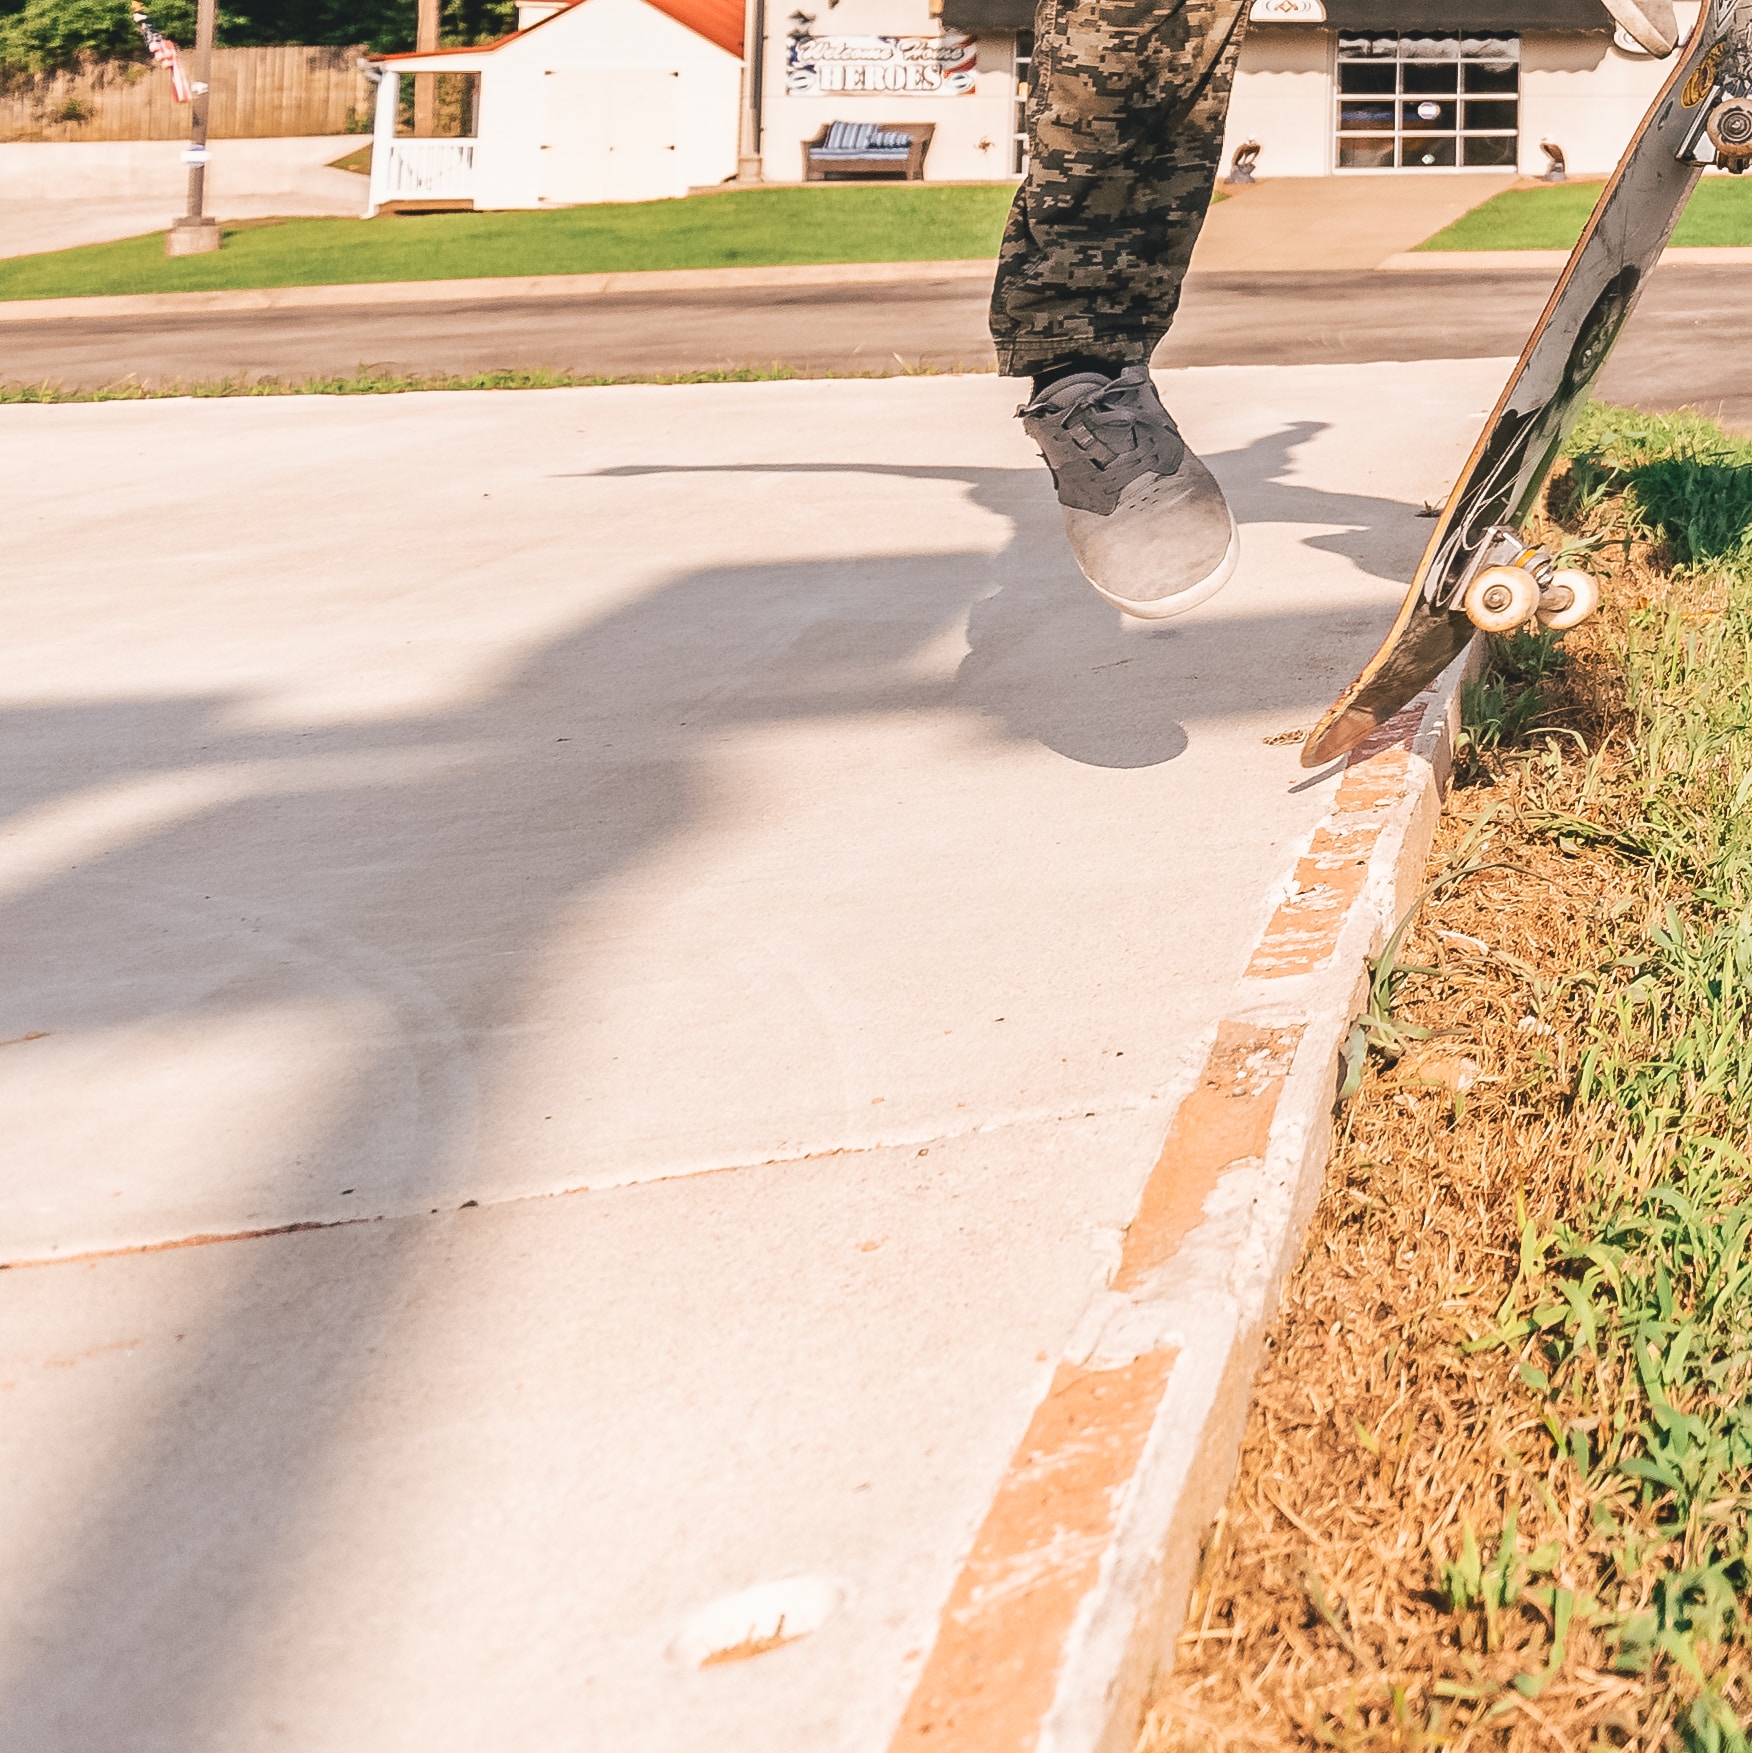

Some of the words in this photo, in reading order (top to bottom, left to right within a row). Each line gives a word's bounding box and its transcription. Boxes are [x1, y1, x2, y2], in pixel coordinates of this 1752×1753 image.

[800, 39, 893, 62] Welcome
[899, 38, 966, 62] Home
[819, 64, 943, 92] HEROES
